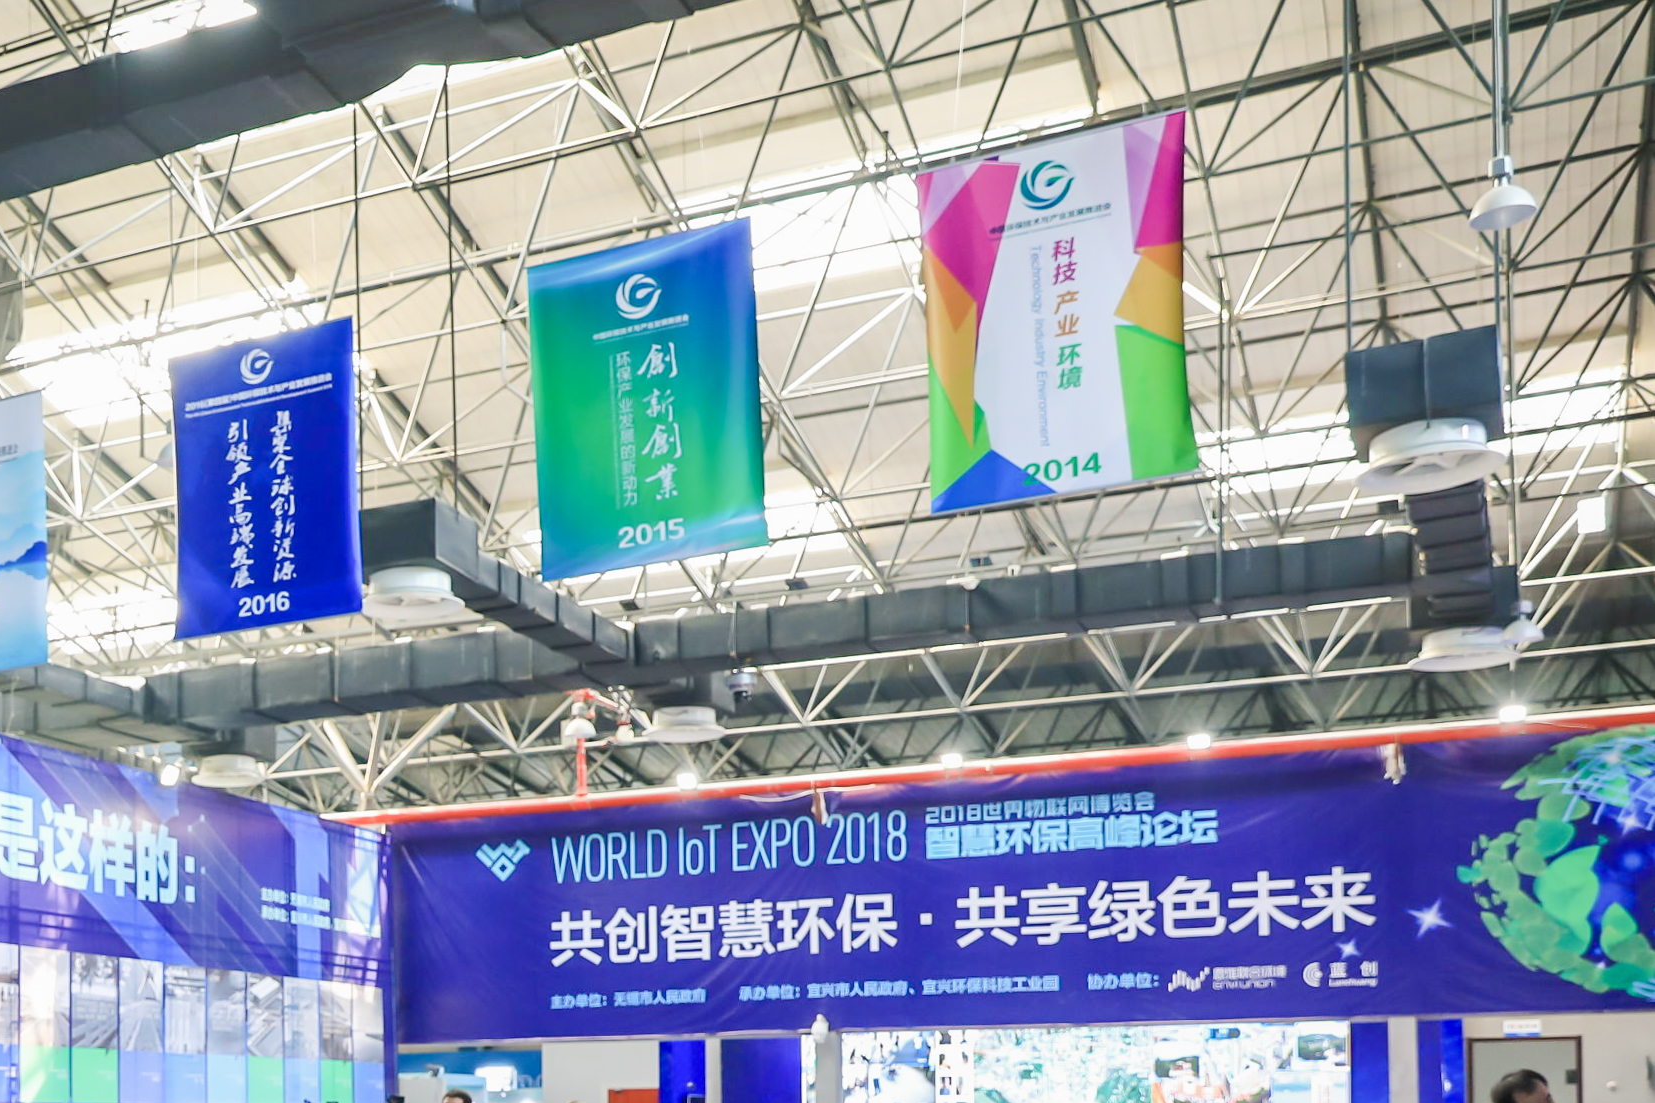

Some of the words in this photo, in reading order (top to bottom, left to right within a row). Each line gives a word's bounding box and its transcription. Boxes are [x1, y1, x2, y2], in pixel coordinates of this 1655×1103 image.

[1030, 246, 1043, 315] Technology
[1034, 319, 1045, 368] Industry
[615, 351, 638, 507] 环保产业发展的新动力
[1022, 453, 1102, 486] 2014
[618, 518, 686, 548] 2015
[238, 591, 291, 618] 2016
[925, 791, 1156, 825] 2018世界物联网博览会
[551, 828, 668, 884] WORLD
[678, 823, 722, 876] IoT
[732, 815, 816, 872] EXPO
[826, 809, 908, 865] 2018
[925, 809, 1219, 860] 智慧环保高峰论坛
